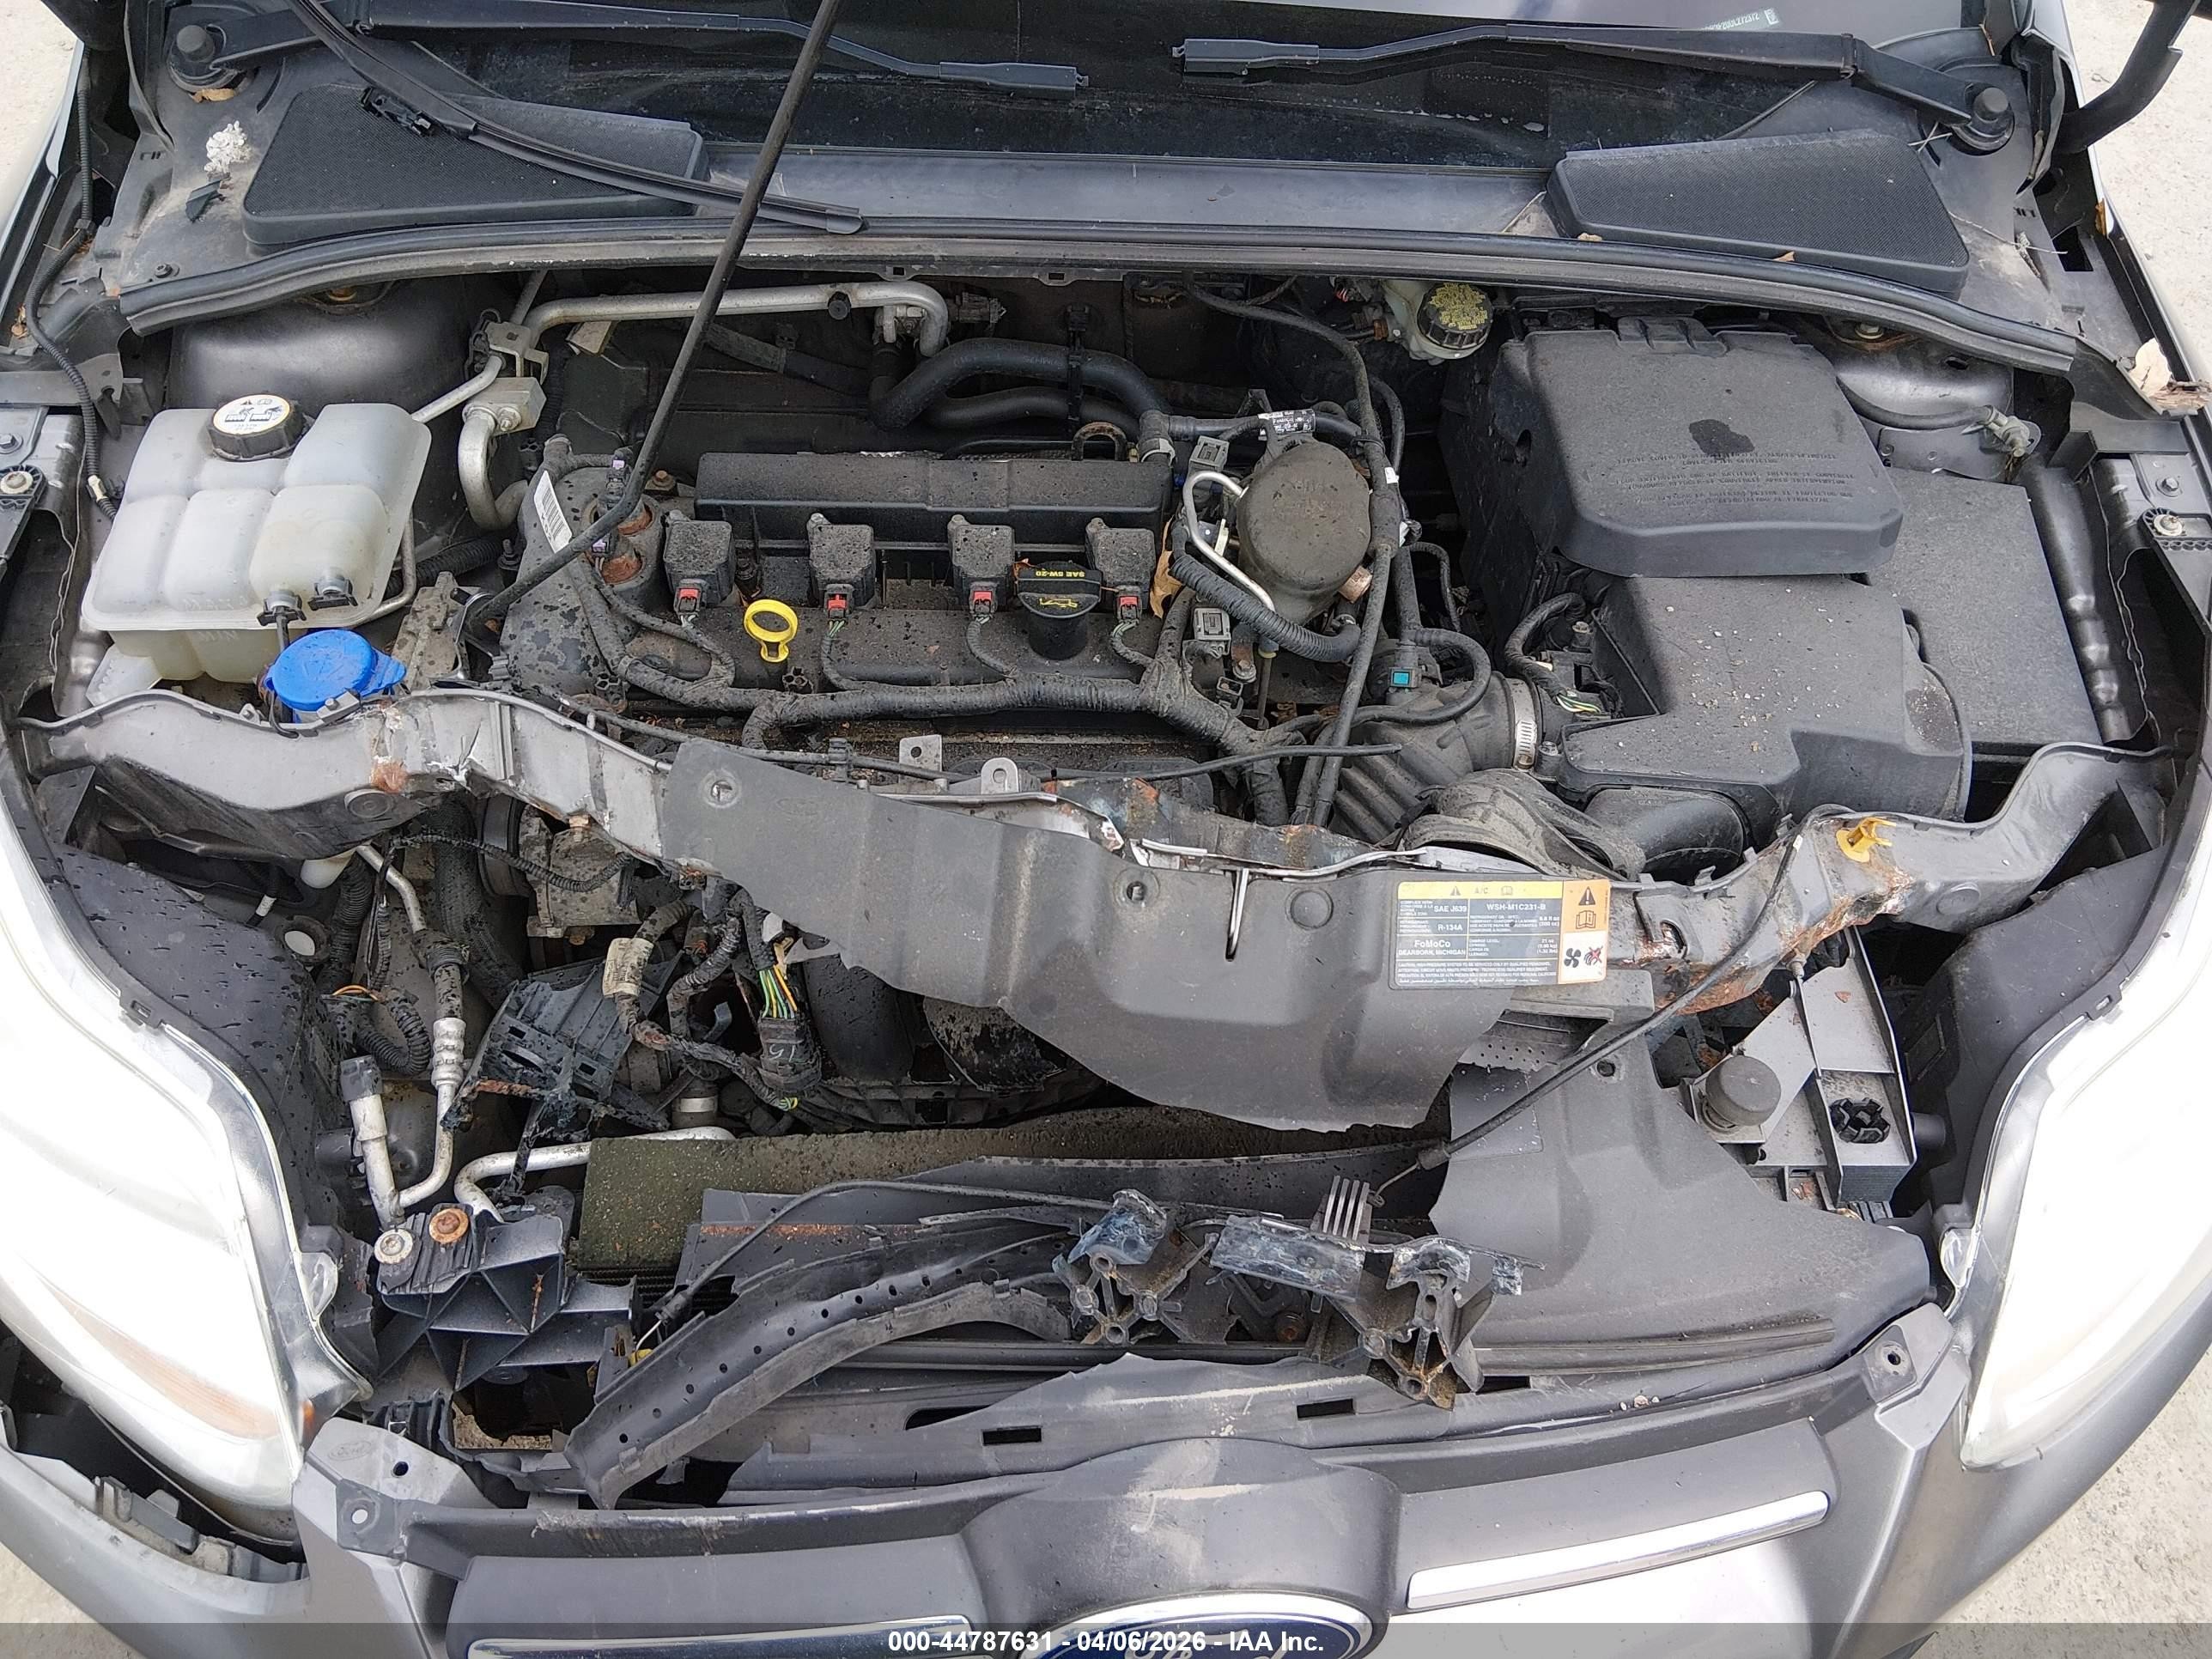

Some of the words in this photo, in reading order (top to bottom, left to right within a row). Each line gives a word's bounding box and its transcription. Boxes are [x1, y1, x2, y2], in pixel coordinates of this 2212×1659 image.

[1450, 905, 1468, 914] J639
[1486, 902, 1547, 911] WSH-M1C231-B
[1437, 923, 1463, 932] R-134A
[1413, 939, 1451, 948] FoMoCo
